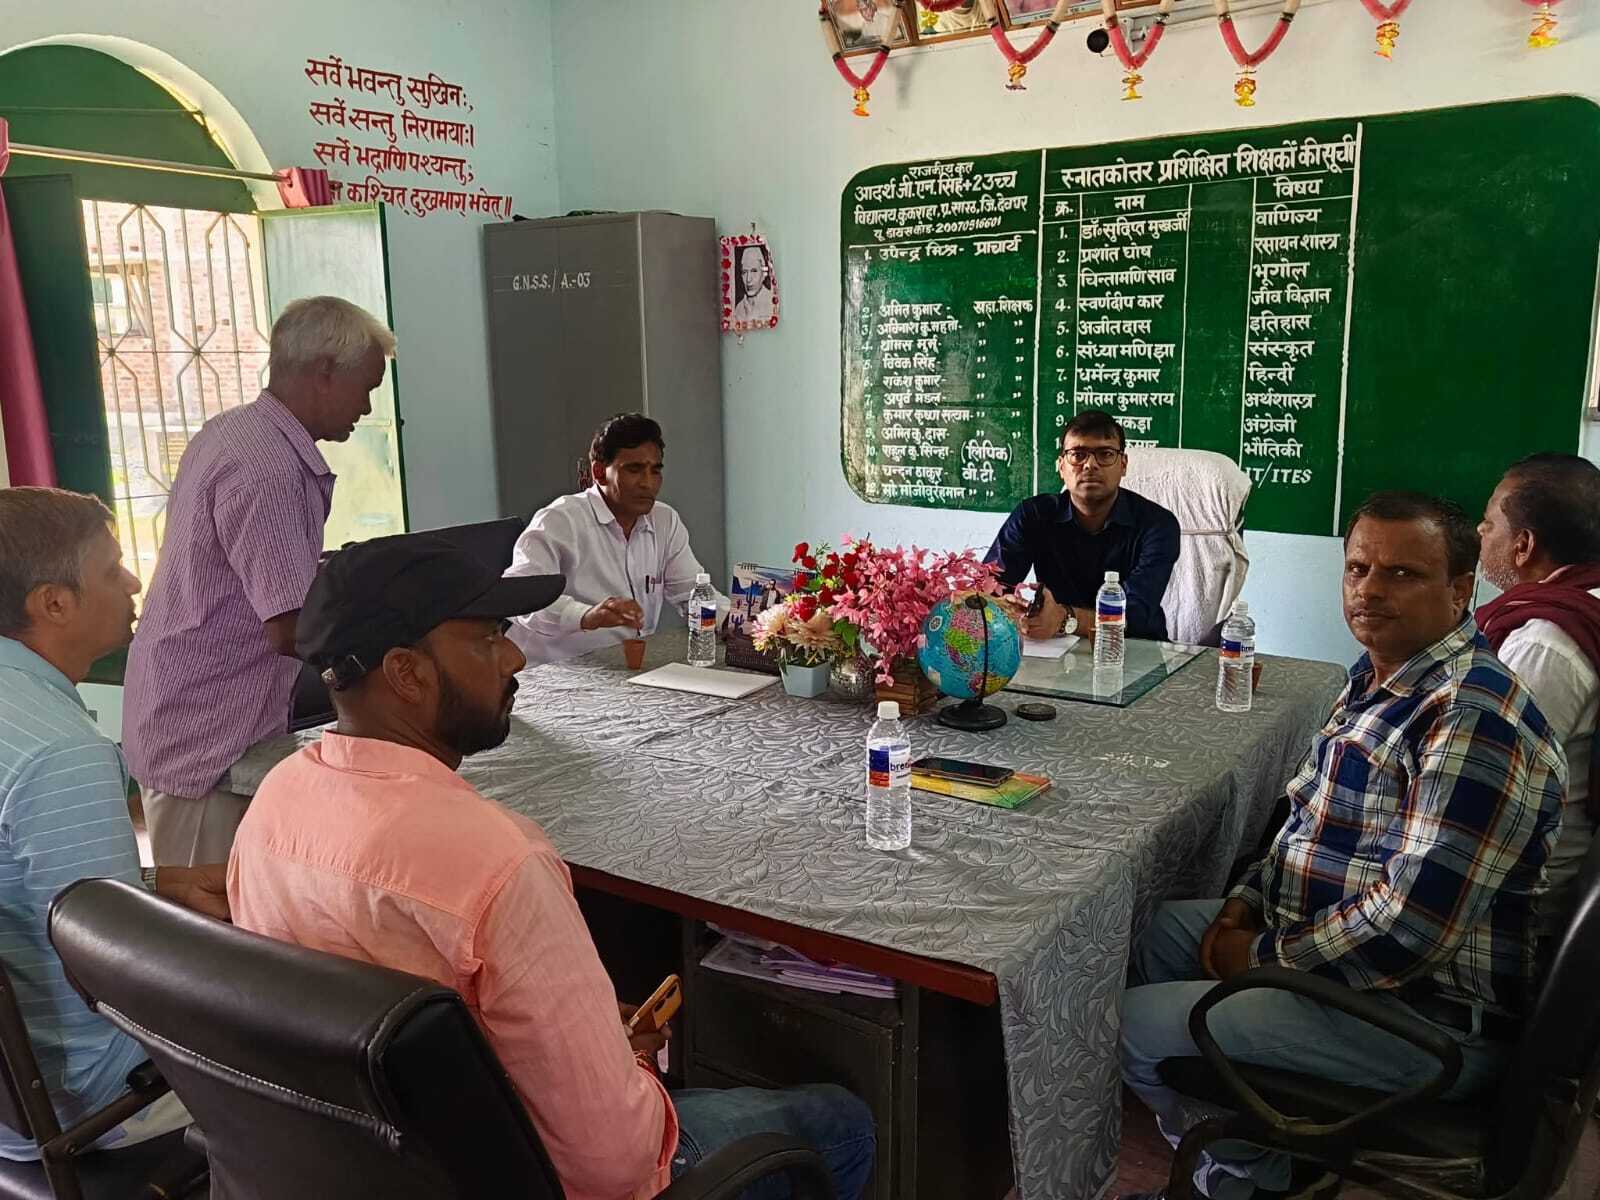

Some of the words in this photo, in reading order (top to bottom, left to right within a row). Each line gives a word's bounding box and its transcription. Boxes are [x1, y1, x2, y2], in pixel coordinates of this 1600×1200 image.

[305, 55, 342, 87] सर्वे
[344, 65, 405, 106] भवन्तु
[309, 97, 347, 128] सर्वे
[349, 108, 397, 143] सन्तु
[313, 136, 351, 166] सर्वे
[353, 145, 406, 174] भद्राणि
[1158, 148, 1231, 184] प्रशिक्षित
[1233, 139, 1299, 177] शिक्षकों
[854, 177, 896, 202] आदर्श
[1113, 194, 1146, 211] नाम
[1273, 176, 1324, 198] विषय
[1060, 226, 1069, 240] 1.
[1256, 204, 1322, 226] वाणिज्य
[973, 234, 1023, 256] प्राचार्य
[1057, 250, 1070, 263] 2.
[1081, 243, 1121, 265] प्रशांत
[1254, 235, 1300, 255] रसायन
[1300, 233, 1341, 251] शास्त्र
[1080, 265, 1147, 288] चिन्तामणि
[1253, 257, 1311, 287] भूगोल
[879, 298, 911, 319] अमित
[911, 303, 943, 321] कुमार
[1055, 298, 1071, 312] 4.
[1137, 294, 1165, 309] कार
[1251, 286, 1282, 305] जीव
[1284, 283, 1332, 310] विज्ञान
[1056, 320, 1070, 335] 5.
[1079, 315, 1122, 335] अजीत
[1122, 319, 1152, 337] दास
[1249, 309, 1313, 336] इतिहास
[883, 352, 911, 369] विवेक
[1056, 345, 1070, 358] 6.
[1078, 340, 1119, 359] संध्या
[1119, 338, 1153, 359] मणि
[1153, 343, 1175, 363] झा
[1248, 337, 1315, 362] संस्कृत
[882, 371, 913, 389] राकेश
[1056, 368, 1068, 382] 7.
[1123, 368, 1160, 388] कुमार
[1247, 361, 1295, 386] हिन्दी
[1056, 391, 1069, 405] 8.
[1076, 385, 1117, 407] गौतम
[1117, 392, 1149, 412] कुमार
[1149, 392, 1175, 407] राय
[882, 409, 914, 425] कुमार
[1055, 414, 1068, 428] 9.
[1243, 413, 1297, 434] अंग्रेजी
[881, 424, 911, 442] अमित
[1243, 436, 1303, 459] भौतिकी
